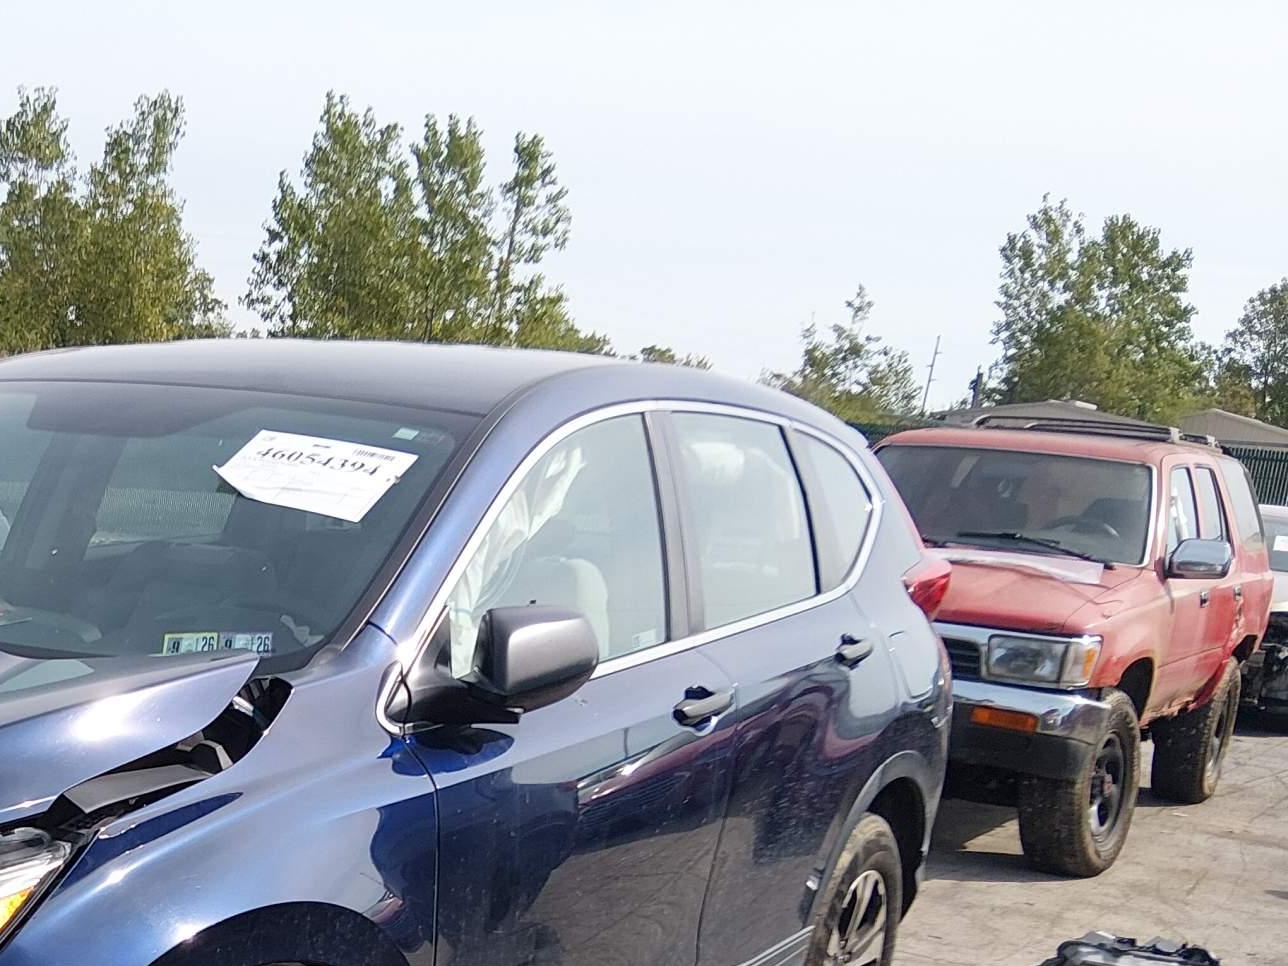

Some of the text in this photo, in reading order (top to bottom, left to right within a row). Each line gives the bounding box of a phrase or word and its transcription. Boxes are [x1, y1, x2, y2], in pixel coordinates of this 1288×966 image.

[256, 447, 381, 476] 46054394
[201, 636, 215, 652] 26
[256, 635, 270, 654] 26
